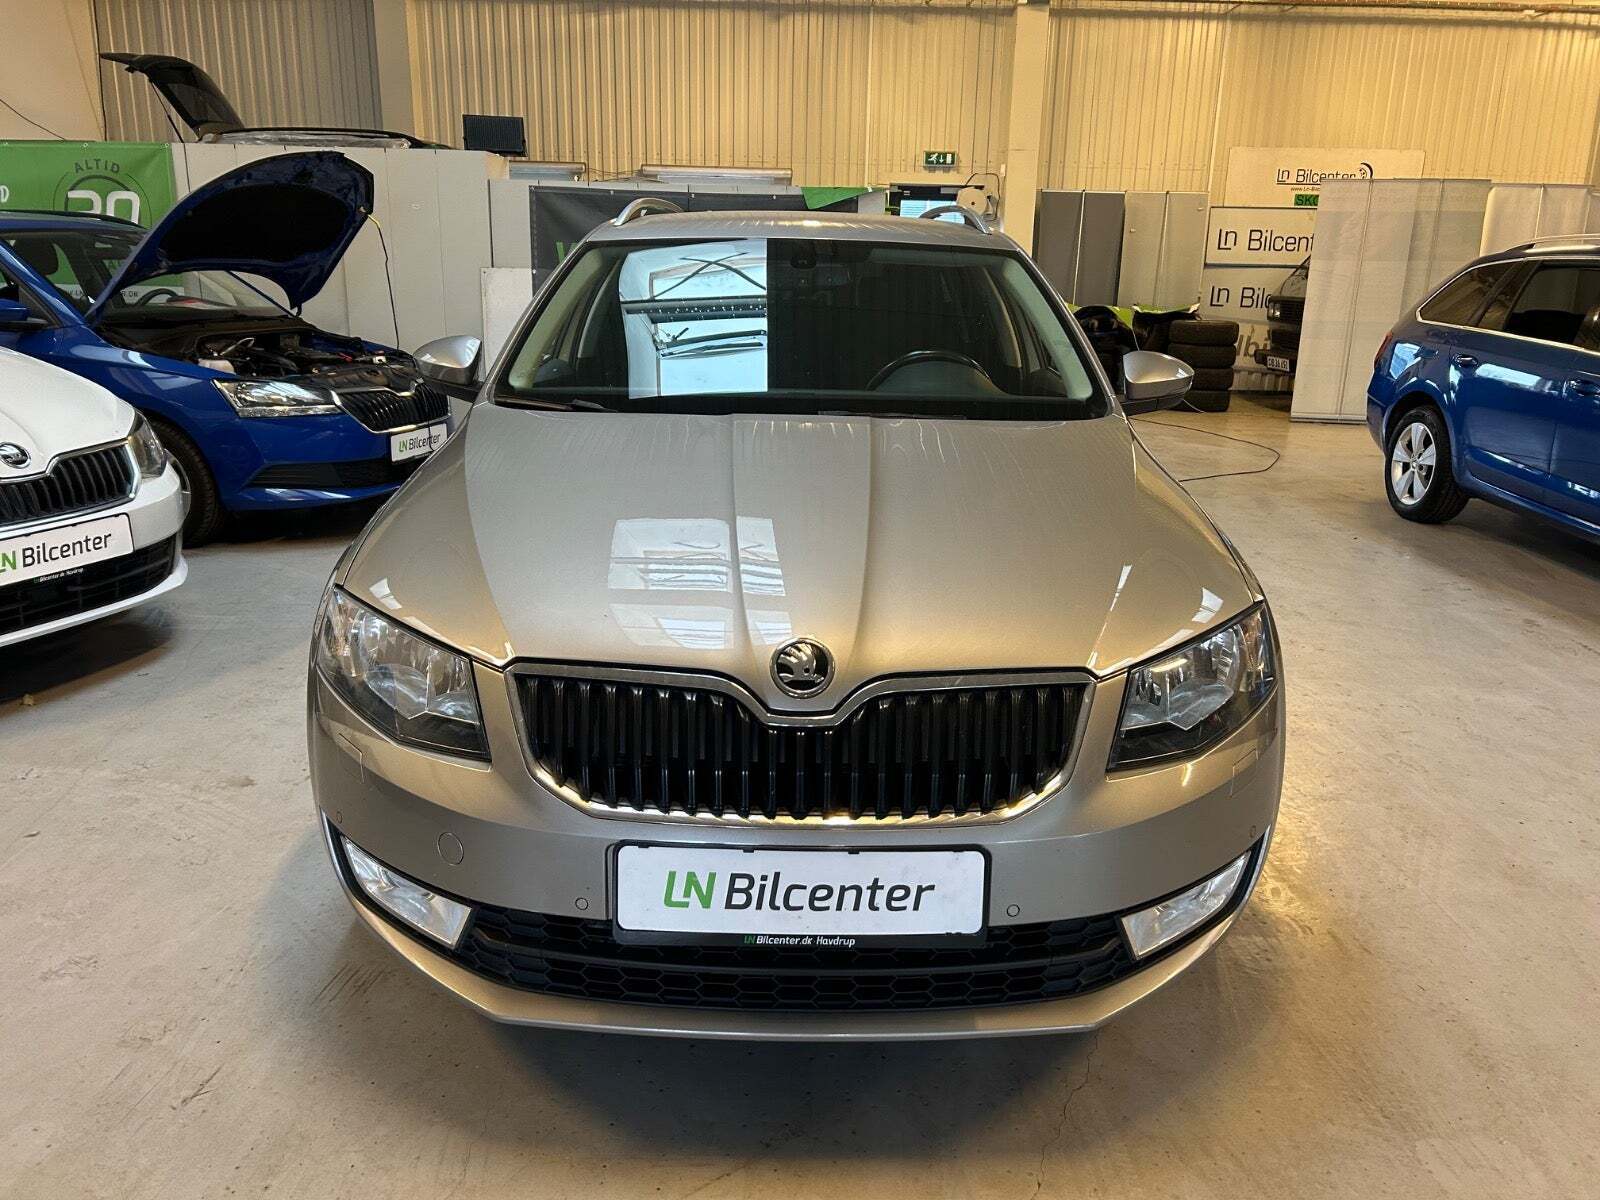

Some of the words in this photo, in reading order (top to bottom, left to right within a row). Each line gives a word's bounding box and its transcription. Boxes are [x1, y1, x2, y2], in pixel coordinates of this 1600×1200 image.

[74, 158, 121, 174] ALTID
[1217, 228, 1237, 250] Ln
[1210, 286, 1230, 307] Ln
[22, 533, 112, 568] Bilcenter
[663, 870, 717, 909] LN
[724, 871, 936, 912] Bilcenter
[816, 935, 856, 948] Havdrup
